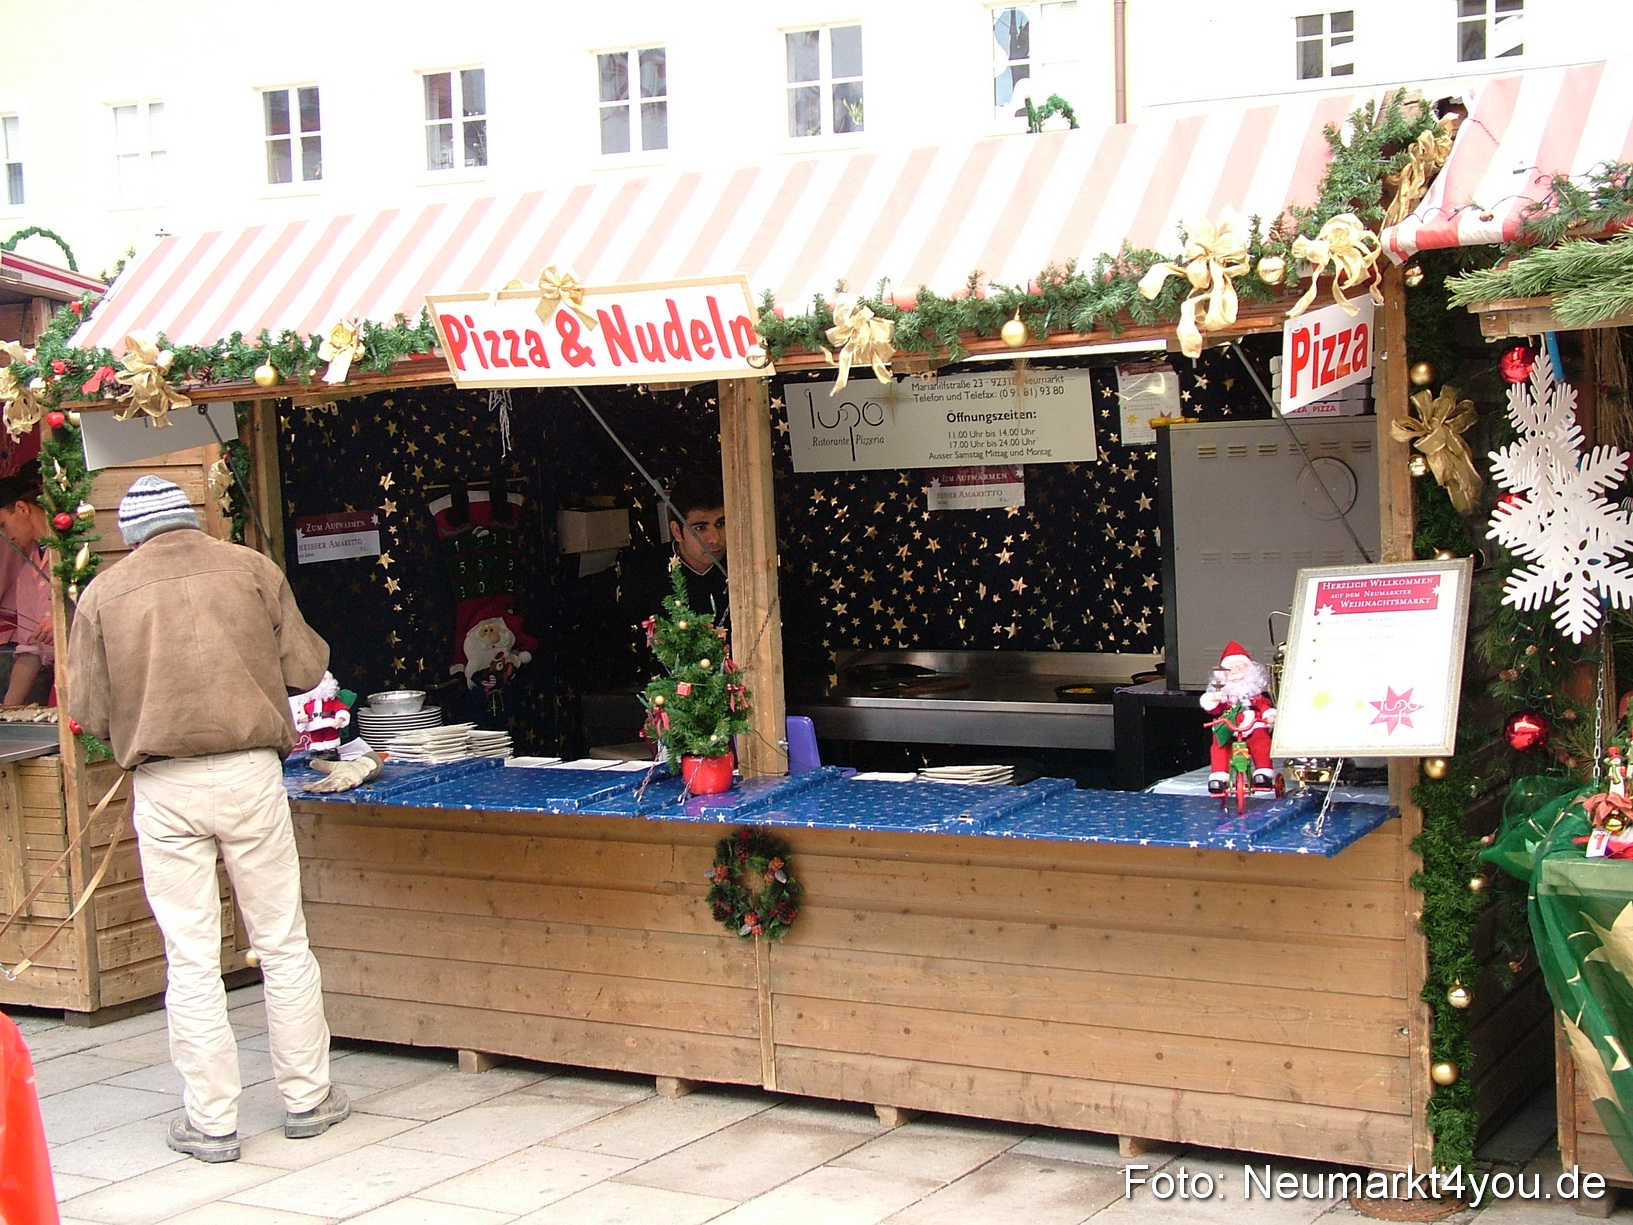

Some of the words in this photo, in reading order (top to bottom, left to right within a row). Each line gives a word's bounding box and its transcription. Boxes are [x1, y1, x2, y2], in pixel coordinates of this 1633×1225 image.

[439, 314, 551, 372] Pizza
[555, 308, 597, 369] &
[596, 295, 757, 367] Nudeln
[1289, 321, 1369, 399] Pizza
[973, 378, 983, 388] 23
[913, 392, 944, 403] Telefon
[946, 390, 962, 401] und
[965, 388, 998, 400] Telefax:
[1039, 386, 1051, 396] 93
[1053, 385, 1064, 395] 80
[1312, 405, 1337, 413] PIZZA
[946, 409, 1037, 424] Öffnungszeiten:
[948, 431, 968, 440] 11.00
[969, 430, 983, 439] Uhr
[985, 429, 996, 438] bis
[998, 428, 1019, 437] 14.00
[1020, 427, 1036, 436] Uhr
[812, 436, 850, 447] Ristorante
[855, 434, 885, 446] Pizzeria
[949, 440, 969, 449] 17.00
[970, 440, 985, 449] Uhr
[986, 439, 997, 448] bis
[999, 438, 1020, 447] 24.00
[1021, 437, 1037, 446] Uhr
[929, 452, 953, 460] Ausser
[955, 450, 984, 460] Samstag
[985, 449, 1008, 459] Mittag
[1009, 448, 1024, 457] und
[1026, 447, 1053, 457] Montag
[958, 489, 1003, 498] AMARETTO
[306, 523, 323, 533] ZUM
[328, 538, 363, 548] AMARETTO
[1322, 581, 1368, 591] HERZLICH
[1369, 577, 1434, 588] WILLKOMMEN
[1363, 589, 1413, 598] NEUMARKTER
[1340, 597, 1432, 608] WEIHNACHTSMARKT
